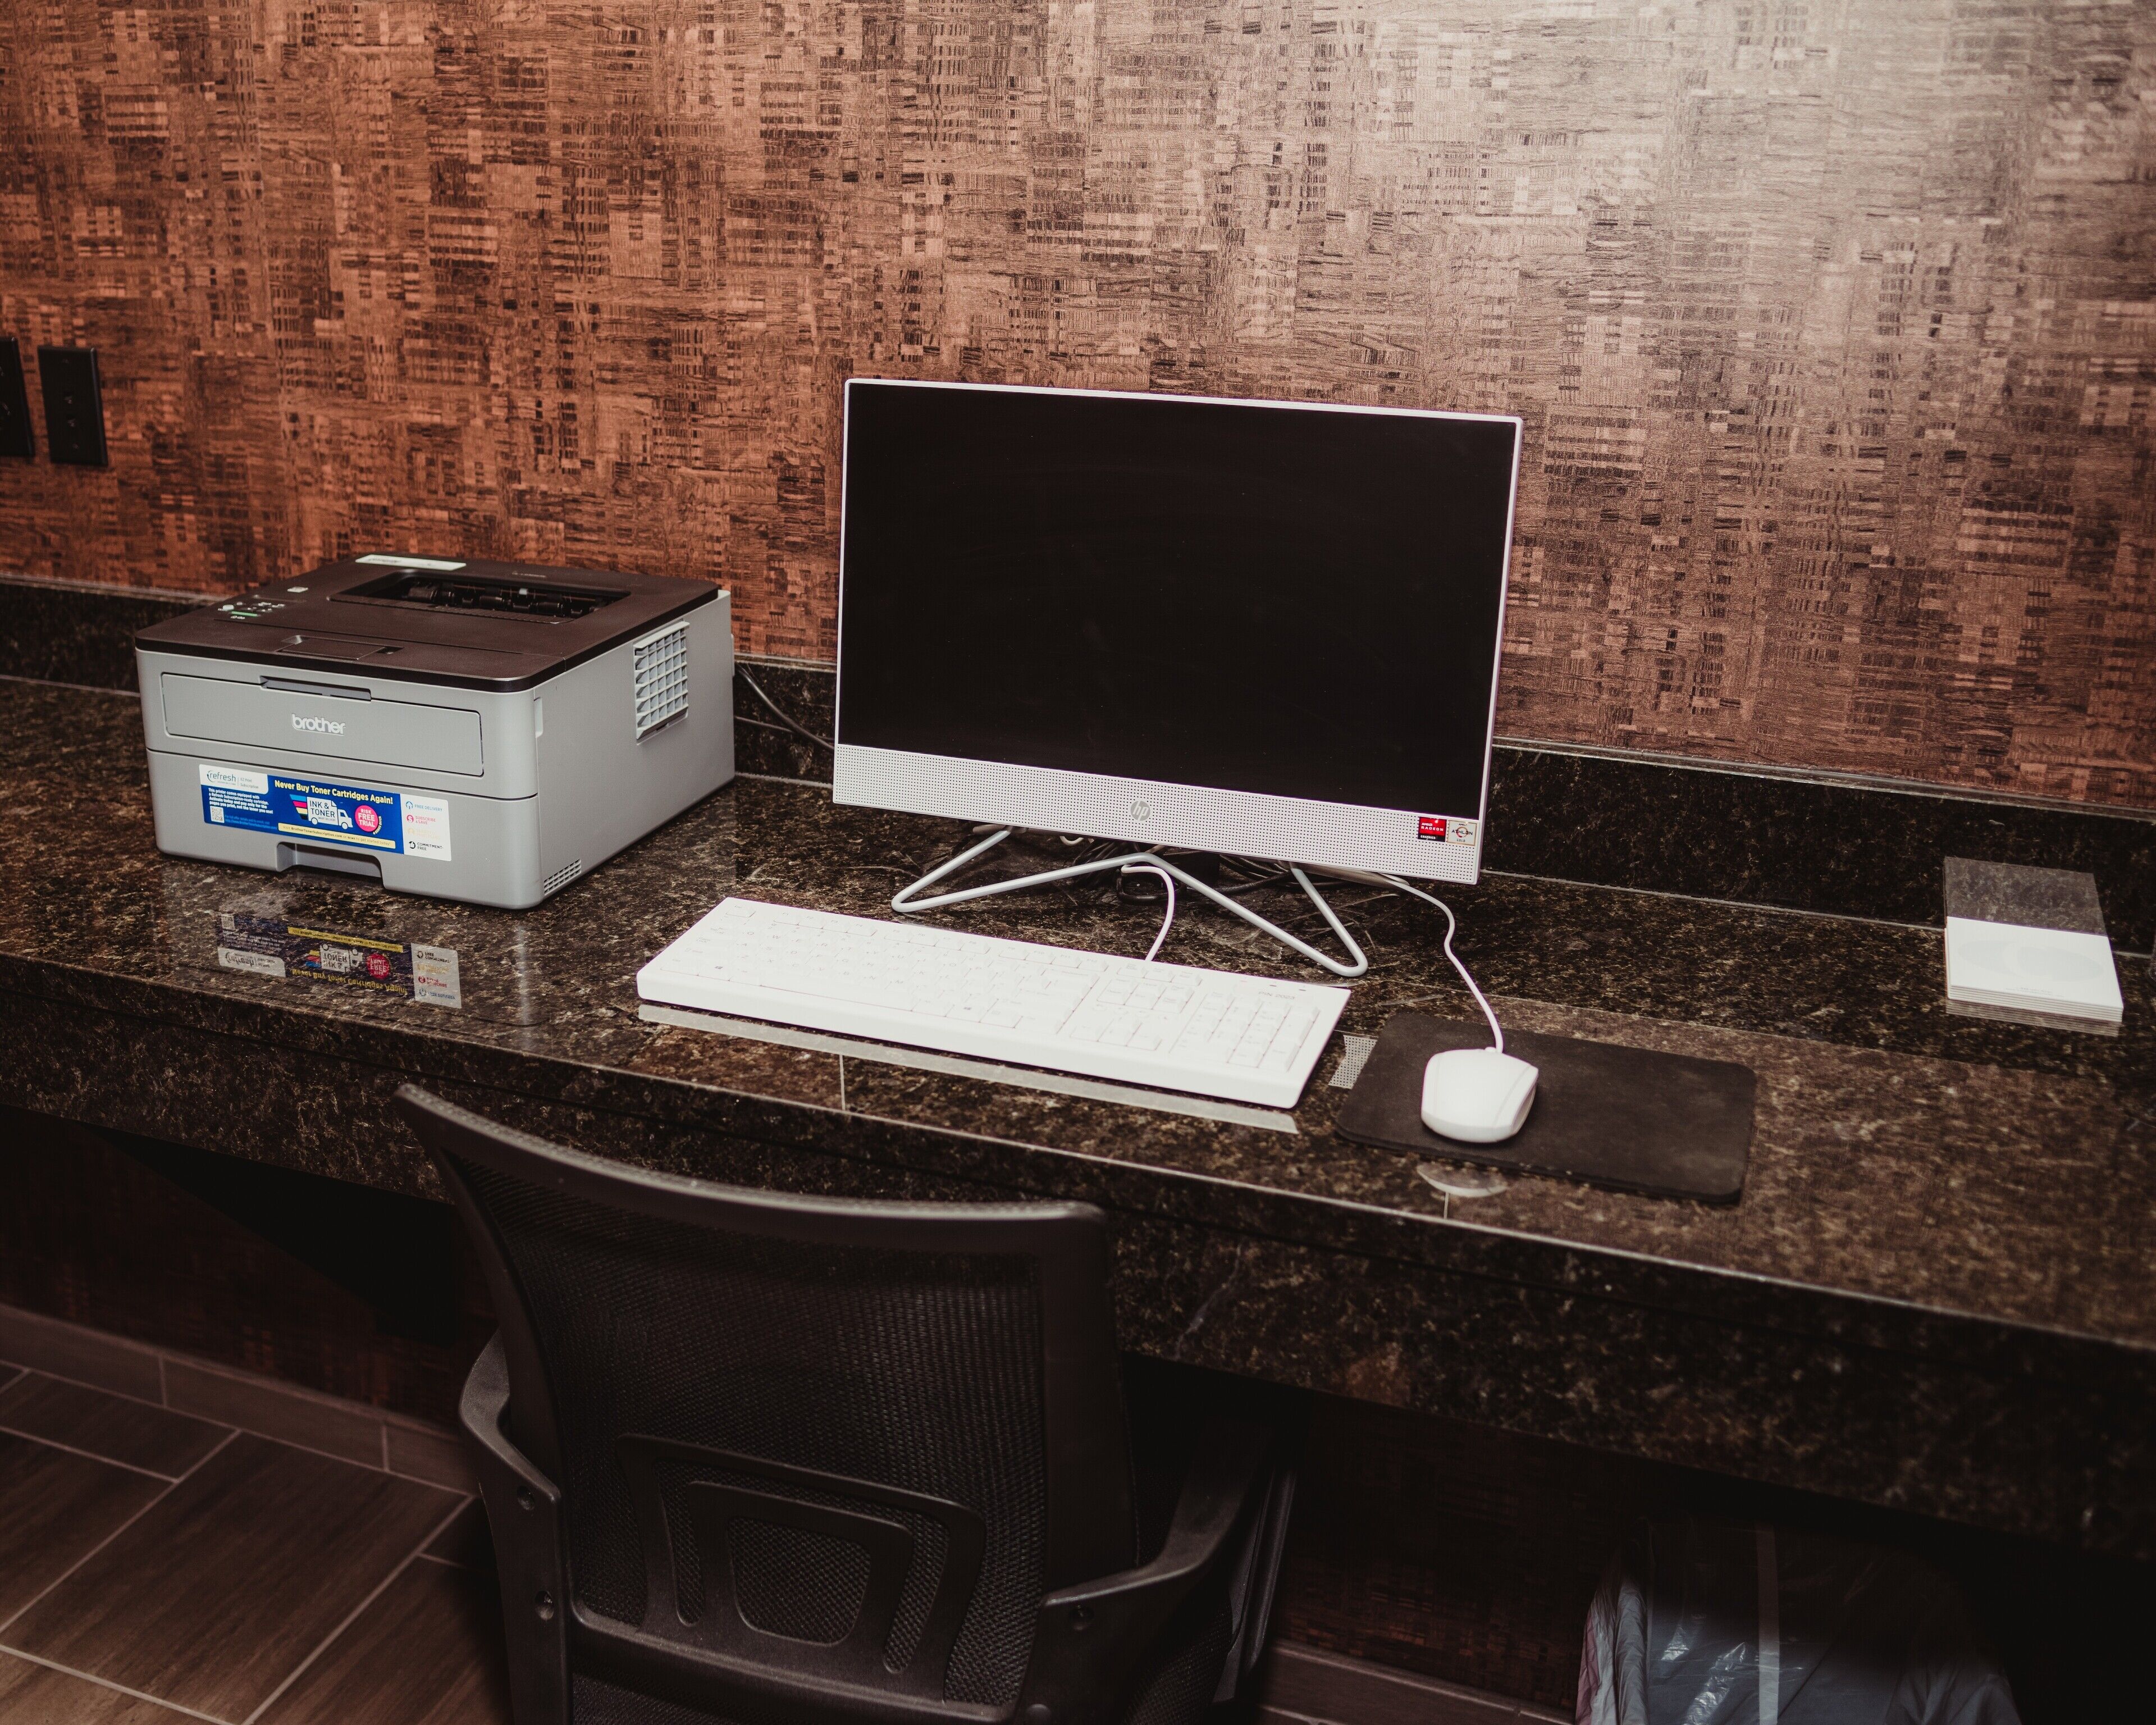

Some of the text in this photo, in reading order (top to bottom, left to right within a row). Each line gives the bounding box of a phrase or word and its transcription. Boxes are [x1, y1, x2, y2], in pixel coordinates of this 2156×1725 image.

[292, 713, 345, 734] brother
[209, 772, 236, 782] refresh
[275, 780, 393, 804] Never Buy Toner Cartridges Again!
[310, 808, 335, 818] TONER
[358, 813, 375, 822] FREE
[1131, 800, 1150, 821] hp
